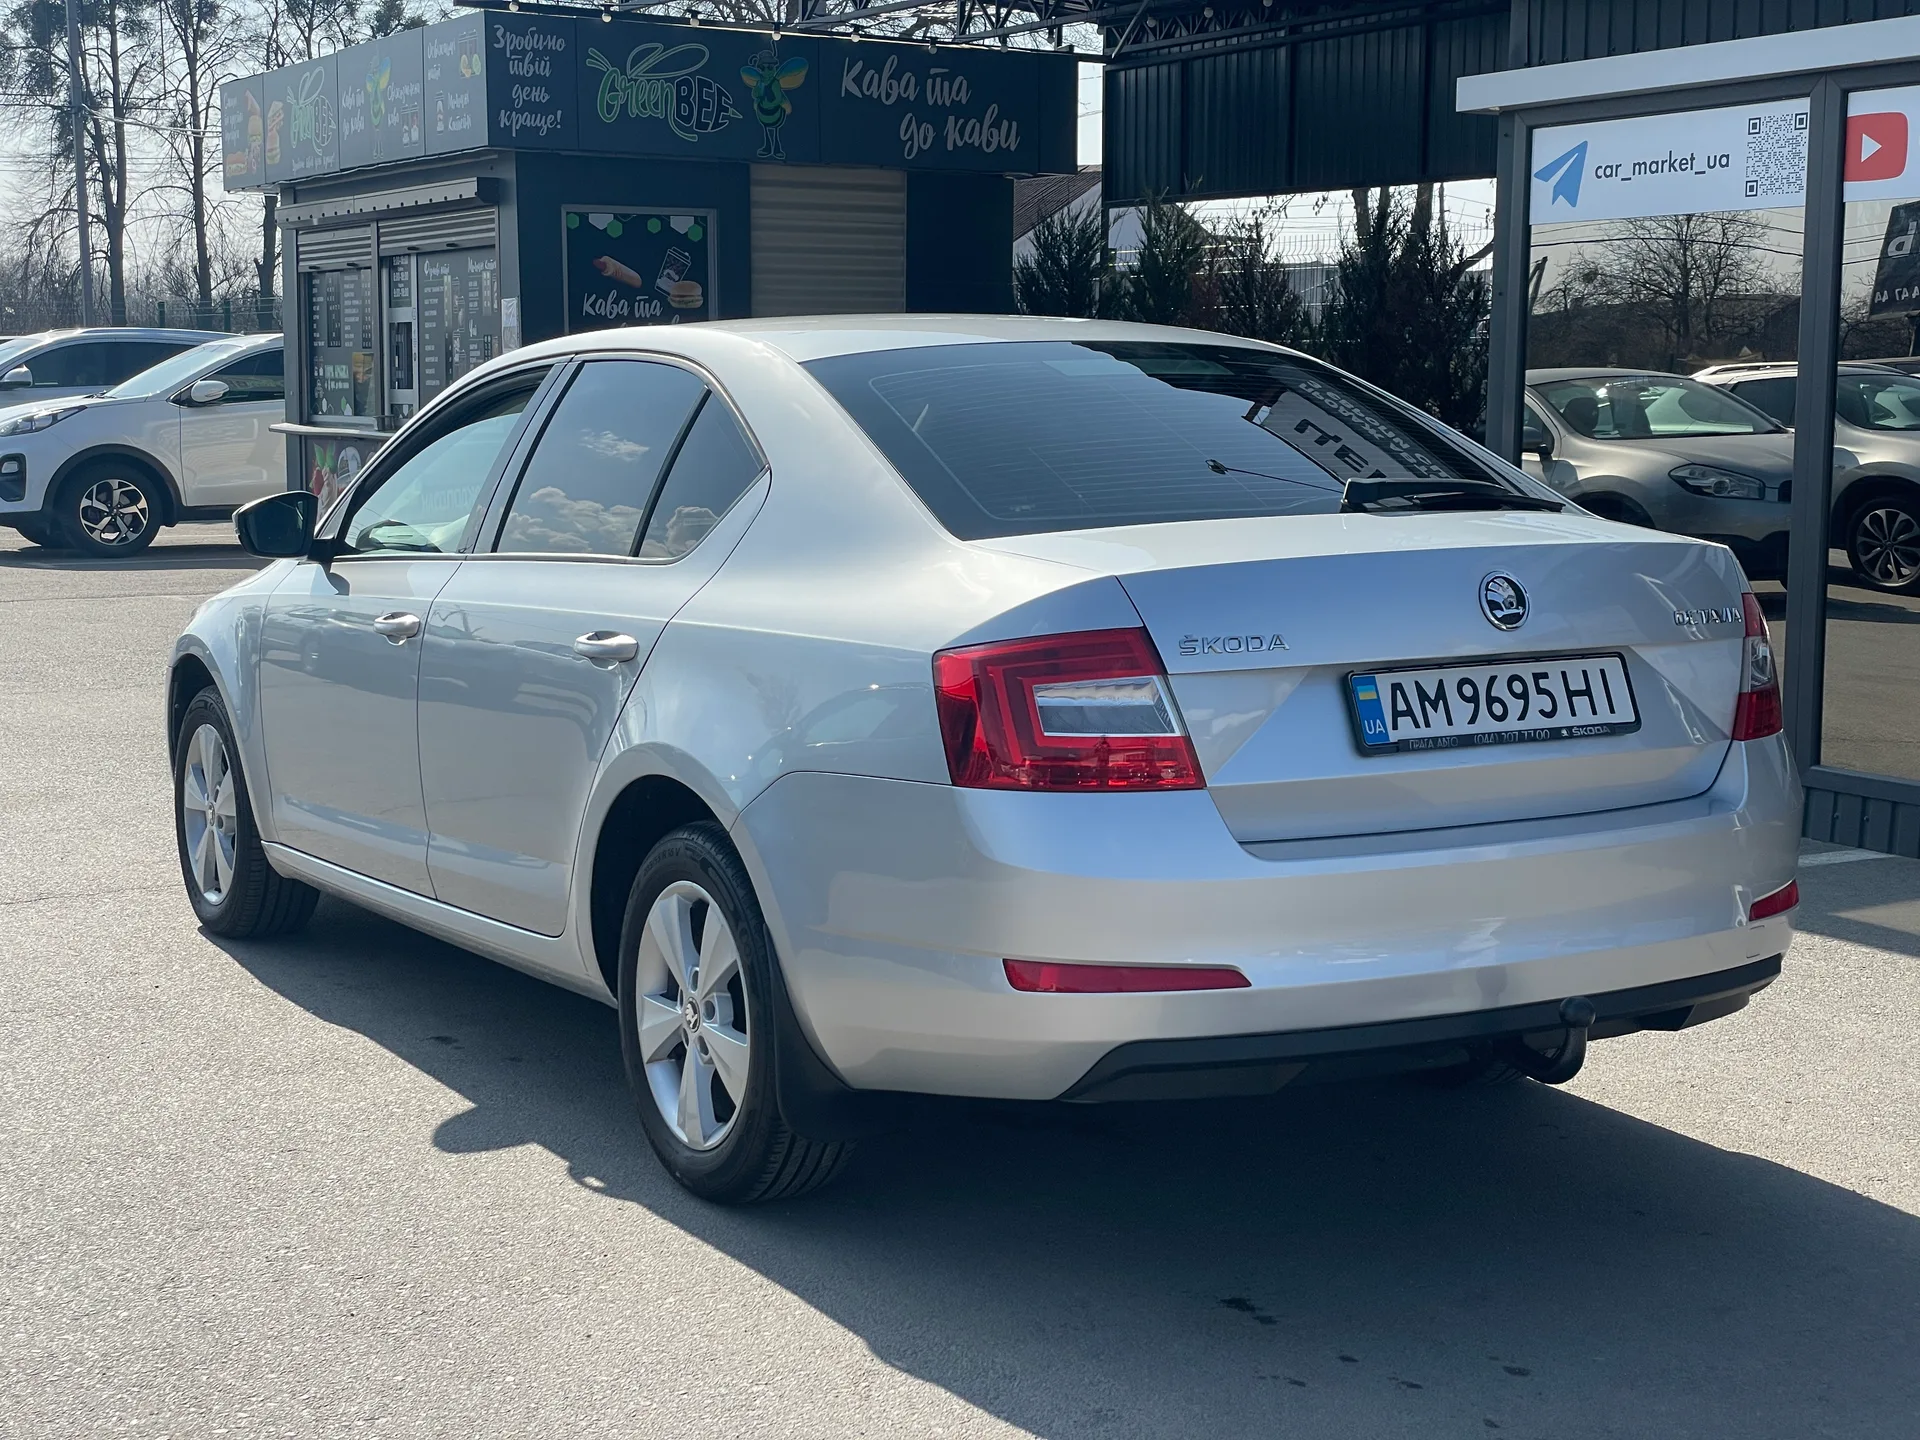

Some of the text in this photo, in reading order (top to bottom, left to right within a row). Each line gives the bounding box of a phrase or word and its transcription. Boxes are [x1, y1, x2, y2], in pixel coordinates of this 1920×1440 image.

[493, 24, 566, 58] Зробимо
[509, 51, 552, 77] твій
[841, 54, 972, 107] Кава та
[512, 84, 550, 109] день
[499, 109, 562, 137] краще!
[900, 103, 1021, 160] до кави
[1594, 149, 1730, 182] car_market_ua
[582, 288, 664, 319] Кава та
[1179, 633, 1290, 656] ŠKODA
[1365, 719, 1386, 735] UA
[1536, 728, 1550, 740] 00
